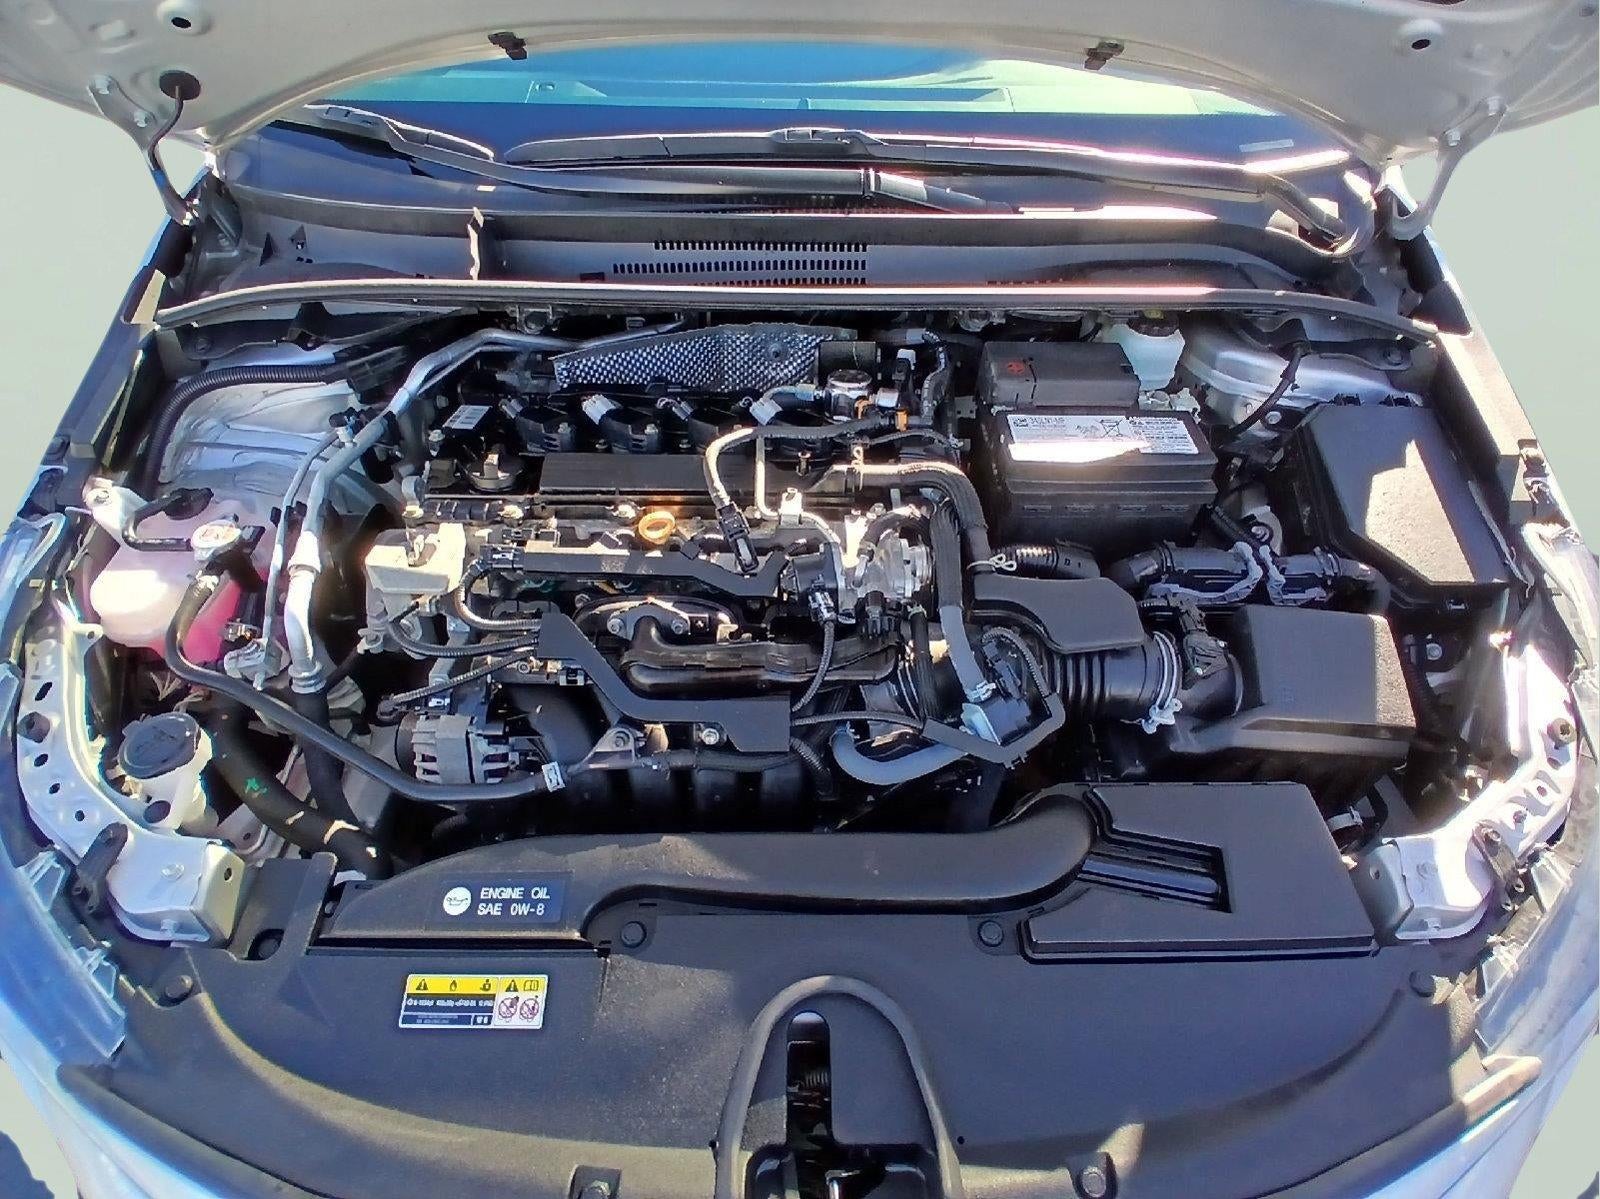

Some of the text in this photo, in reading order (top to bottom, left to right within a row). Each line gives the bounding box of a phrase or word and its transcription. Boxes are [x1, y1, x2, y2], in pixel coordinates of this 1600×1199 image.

[480, 887, 551, 899] ENGINE OIL
[477, 902, 545, 915] SAE 0W-8
